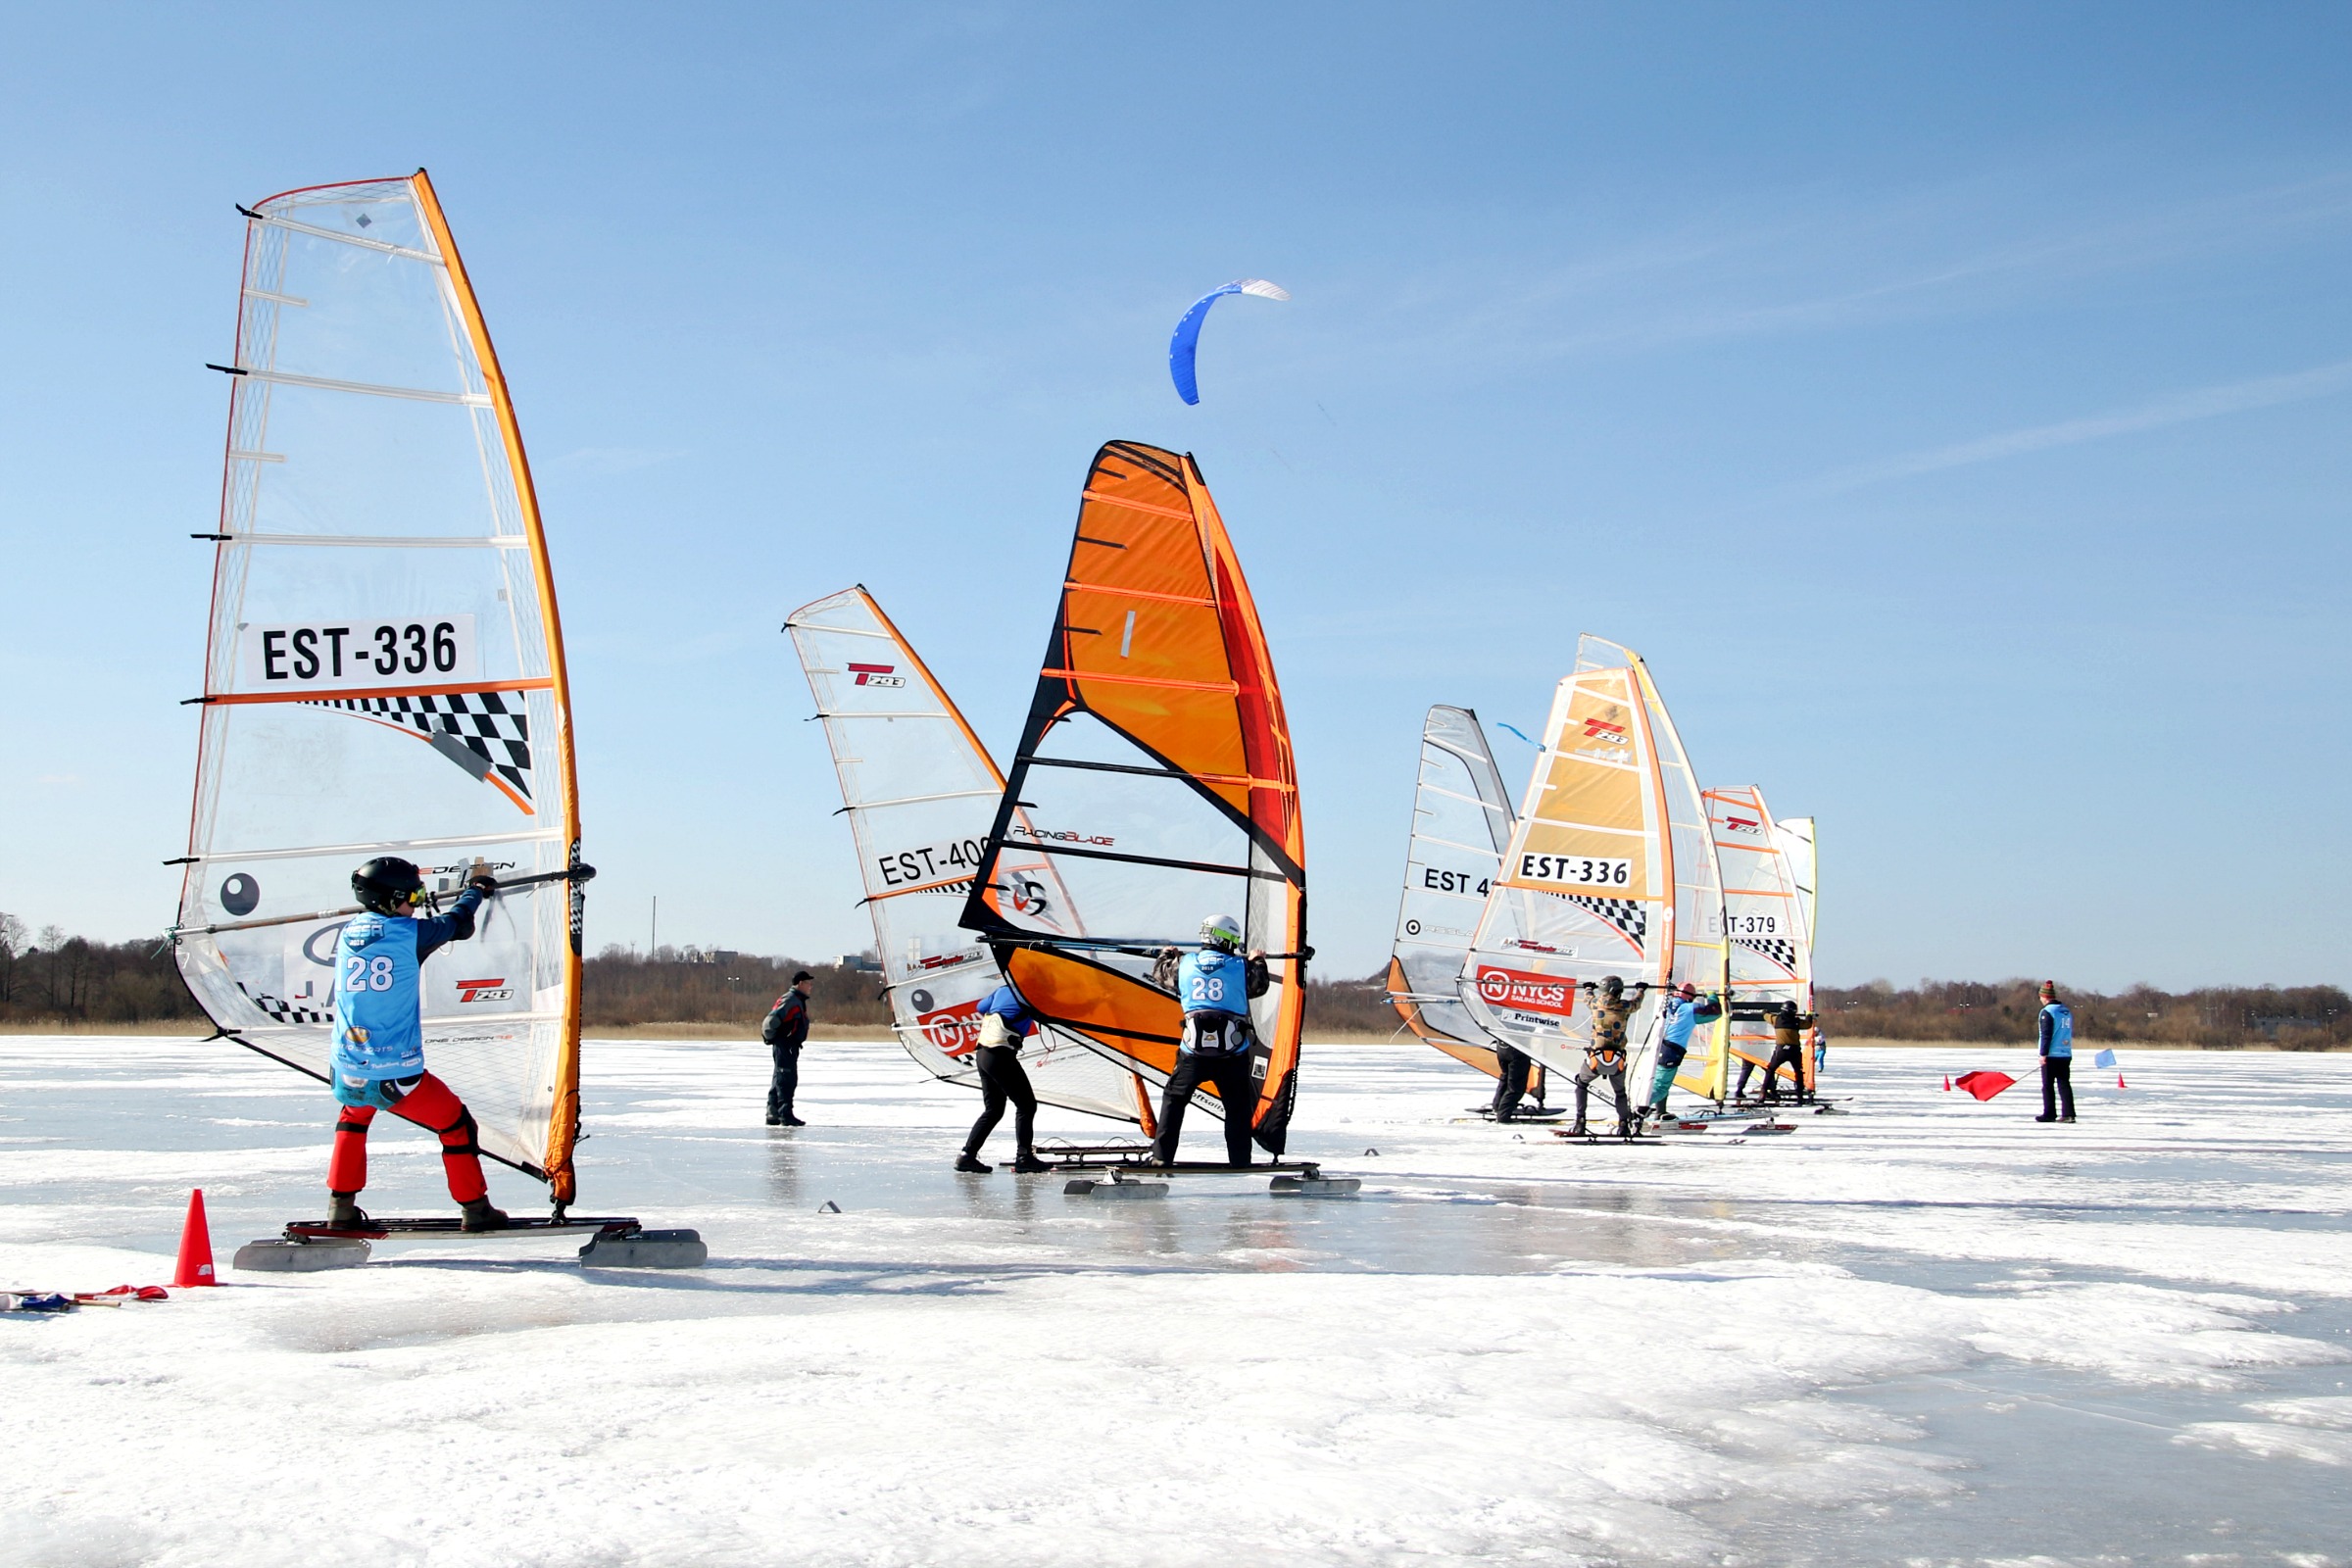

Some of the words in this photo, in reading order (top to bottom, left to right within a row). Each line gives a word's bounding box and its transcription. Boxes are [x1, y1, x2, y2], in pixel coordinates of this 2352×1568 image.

[263, 621, 457, 680] EST-336
[846, 662, 906, 689] T293
[1424, 867, 1471, 894] EST
[1521, 855, 1628, 884] EST-336
[456, 978, 514, 1004] T293
[1191, 977, 1224, 1001] 28
[1511, 995, 1536, 1004] SAILING
[1536, 999, 1563, 1008] SCHOOL
[1512, 979, 1565, 1002] NYCS
[1514, 1012, 1560, 1027] Printwise
[1596, 1089, 1615, 1102] Sport
